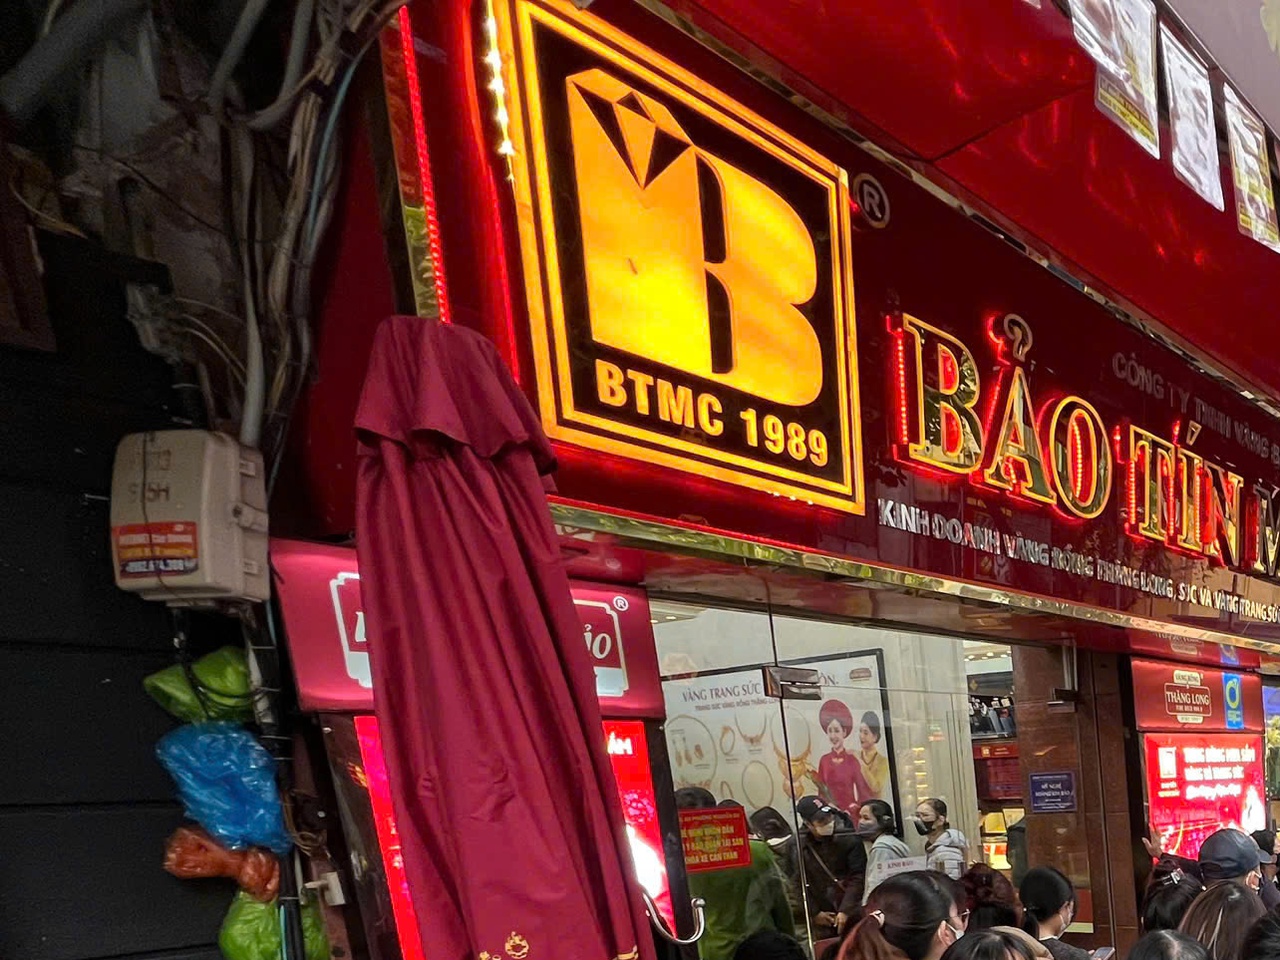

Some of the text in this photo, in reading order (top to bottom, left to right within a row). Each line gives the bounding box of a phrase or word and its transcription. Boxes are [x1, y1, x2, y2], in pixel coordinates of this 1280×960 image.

[594, 359, 828, 467] BTMC 1989
[1112, 352, 1164, 400] CÔNG
[1167, 381, 1190, 414] TY
[902, 313, 1113, 519] BẢO
[1128, 420, 1245, 567] TÍN
[877, 498, 931, 537] KINH
[931, 513, 1001, 555] DOANH
[1003, 531, 1049, 565] VÀNG
[1051, 543, 1094, 576] RỒNG
[1097, 558, 1140, 588] THĂNG
[1178, 582, 1199, 605] SJC
[1199, 582, 1213, 608] VÀ
[1213, 588, 1239, 615] VÀNG
[1239, 599, 1267, 621] TRANG
[682, 688, 708, 703] VÀNG
[709, 685, 742, 700] TRANG
[742, 680, 762, 696] SỨC
[1166, 690, 1210, 706] THĂNG LONG
